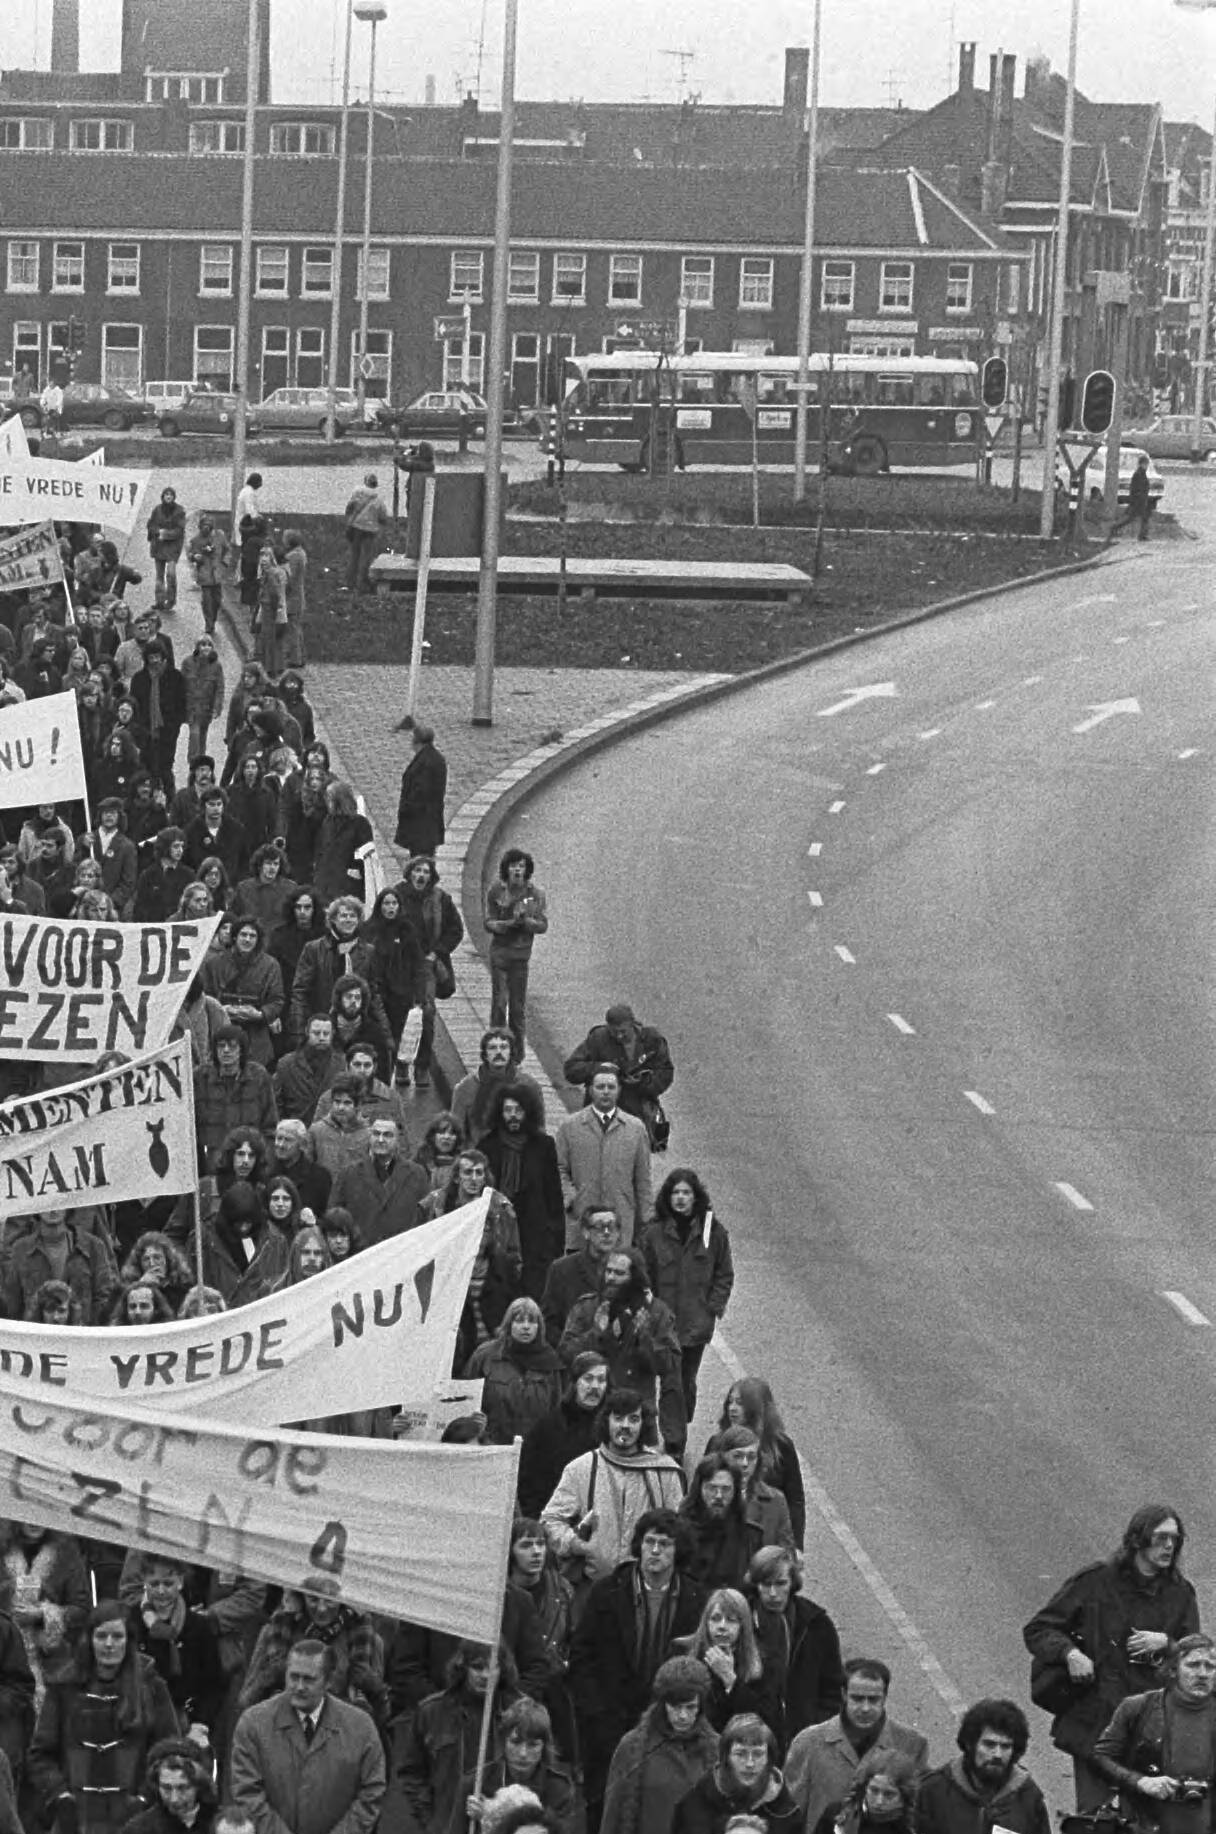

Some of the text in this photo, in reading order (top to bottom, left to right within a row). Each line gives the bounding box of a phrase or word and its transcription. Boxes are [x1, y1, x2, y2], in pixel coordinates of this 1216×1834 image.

[26, 477, 85, 498] VREDE
[4, 923, 124, 989] VOOR
[138, 925, 200, 987] DE
[0, 1349, 68, 1387] DE
[109, 1317, 288, 1390] VREDE
